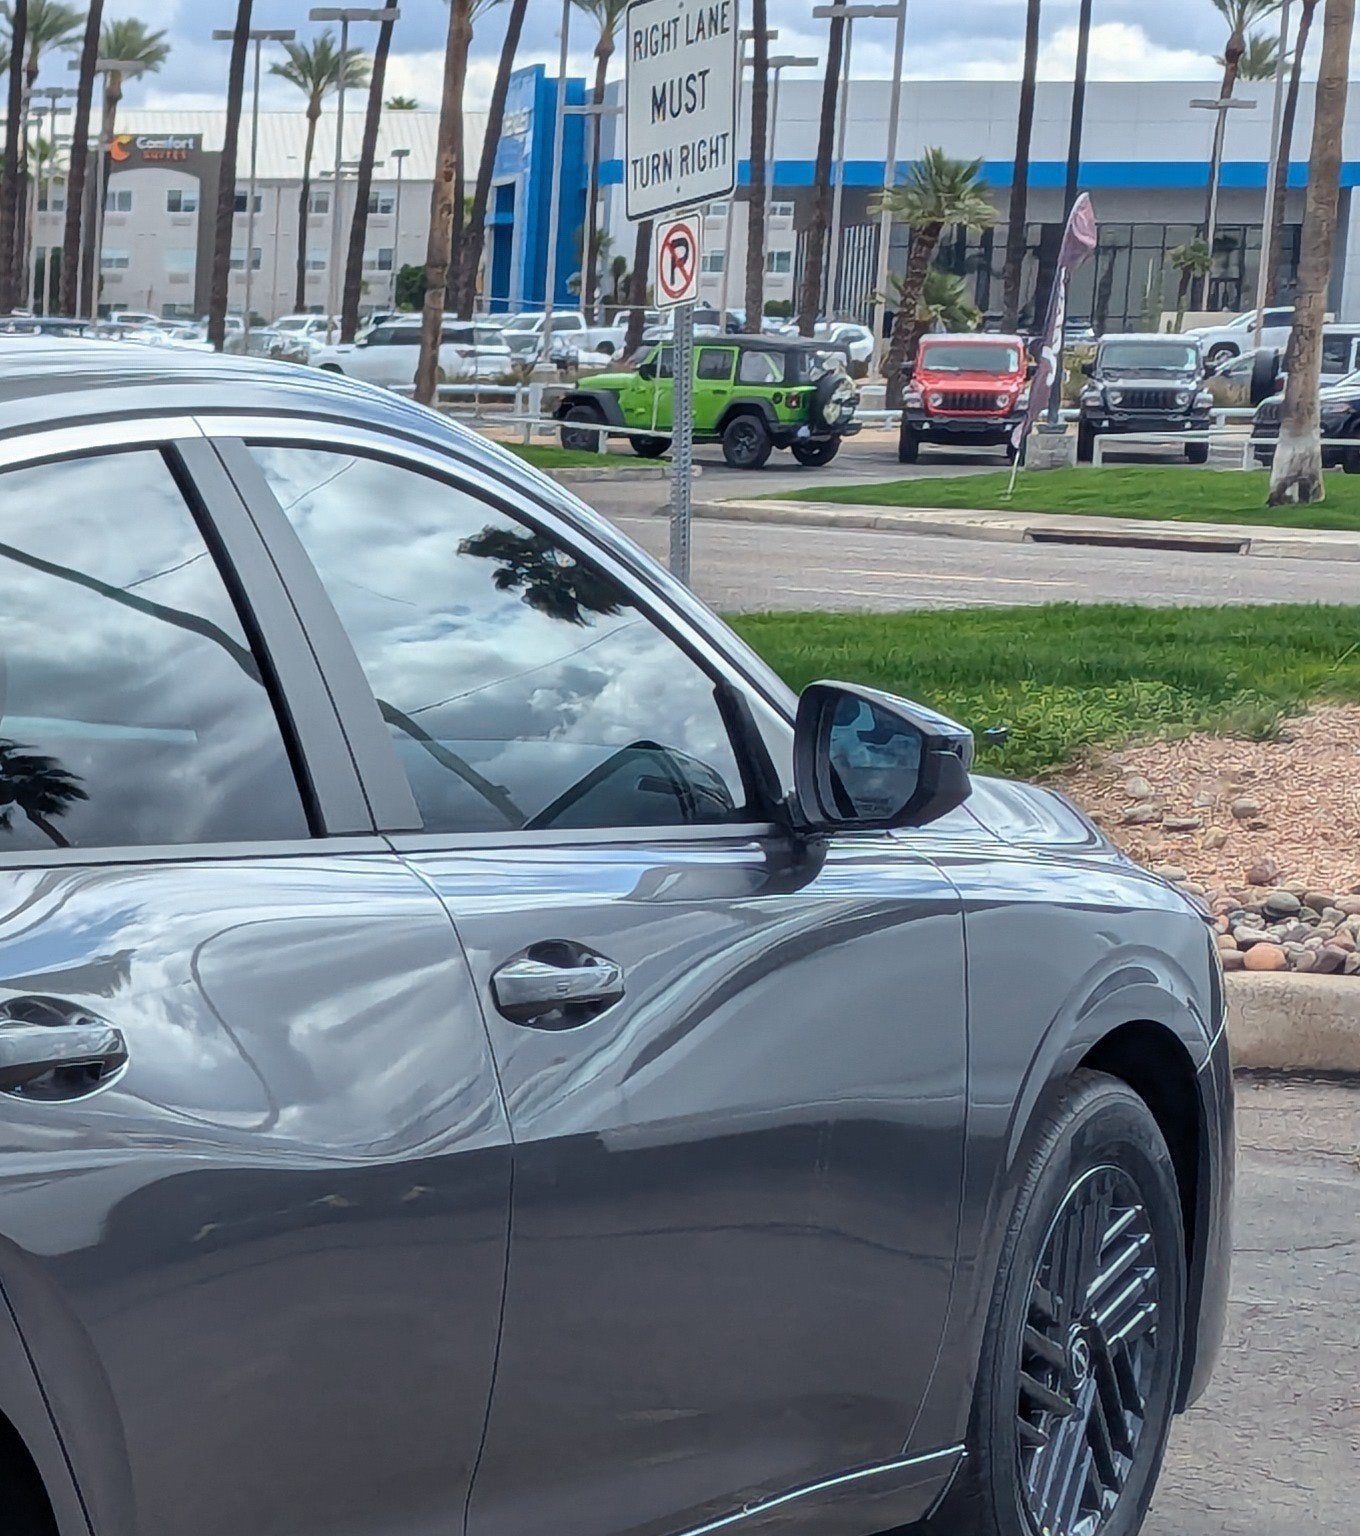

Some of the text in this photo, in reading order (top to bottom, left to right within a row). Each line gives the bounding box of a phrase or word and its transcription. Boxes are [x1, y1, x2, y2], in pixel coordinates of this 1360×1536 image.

[632, 1, 730, 62] RIGHT LANE
[651, 69, 710, 124] MUST
[135, 135, 194, 149] Comfort
[632, 132, 729, 191] TURN RIGHT
